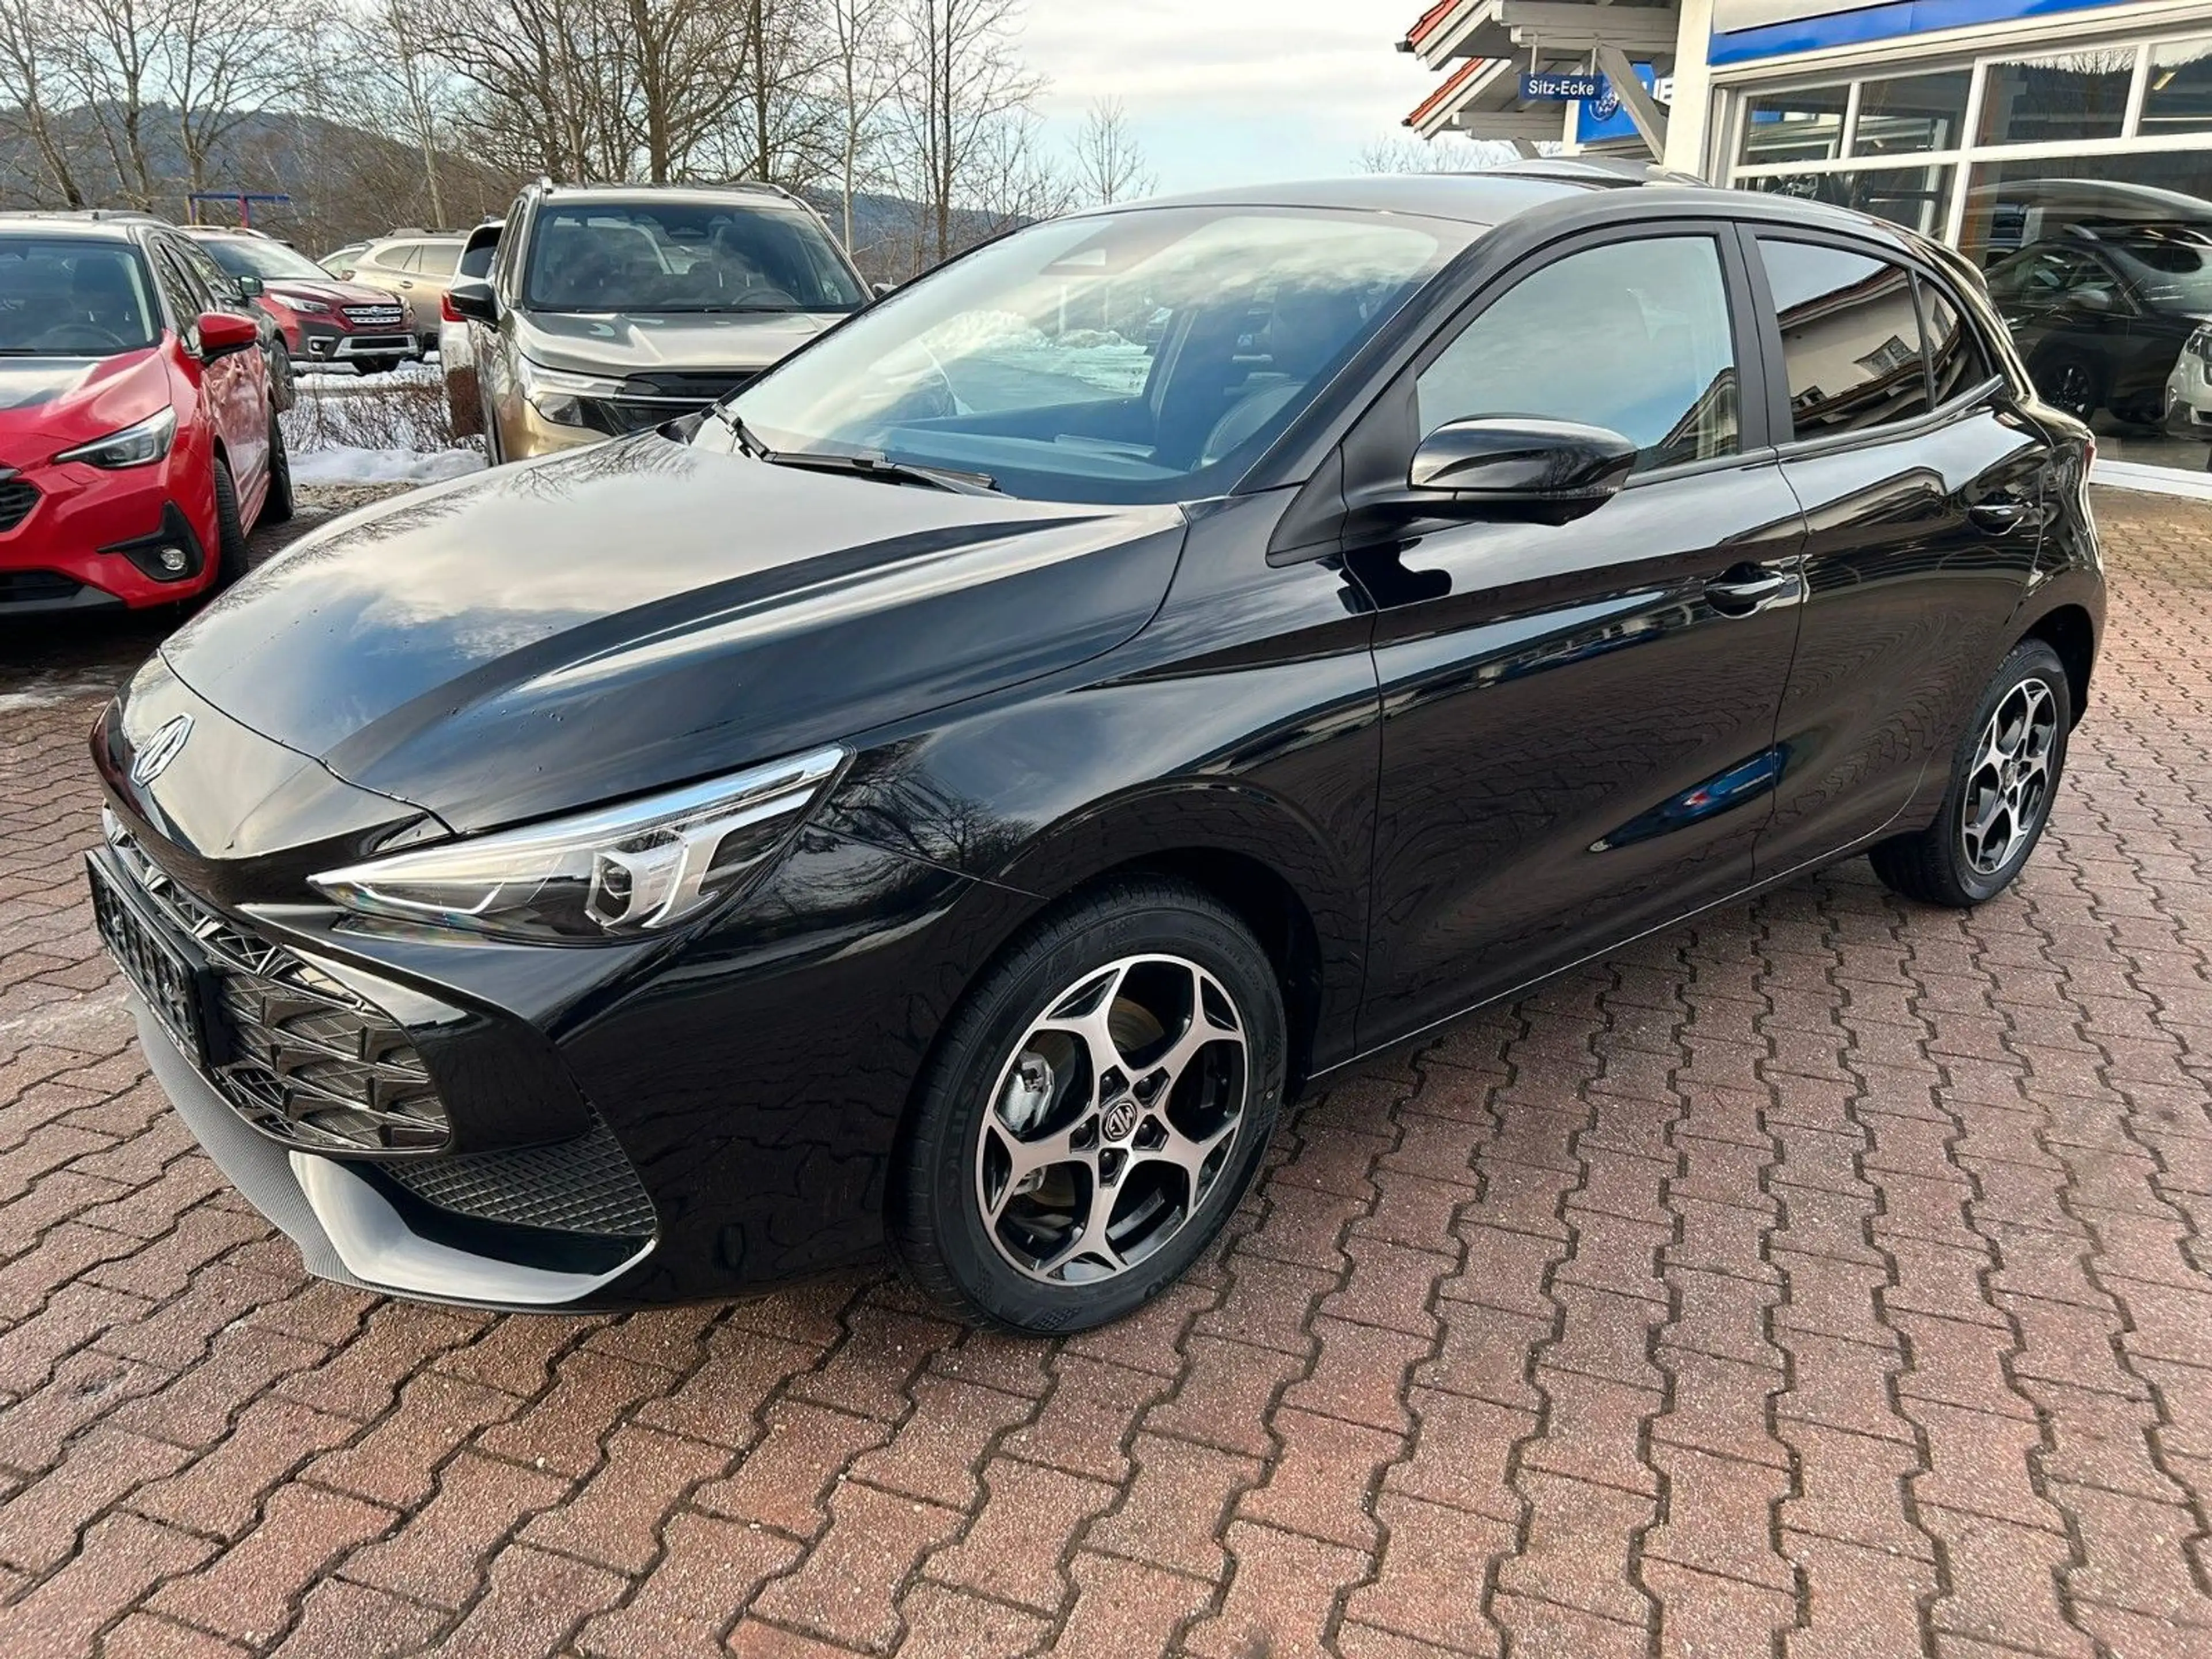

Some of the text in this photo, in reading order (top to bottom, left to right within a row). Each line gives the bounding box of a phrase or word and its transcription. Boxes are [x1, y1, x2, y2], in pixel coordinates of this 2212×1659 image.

[1528, 79, 1595, 96] Sitz-Ecke
[133, 715, 191, 784] MG
[1107, 1105, 1135, 1138] MG
